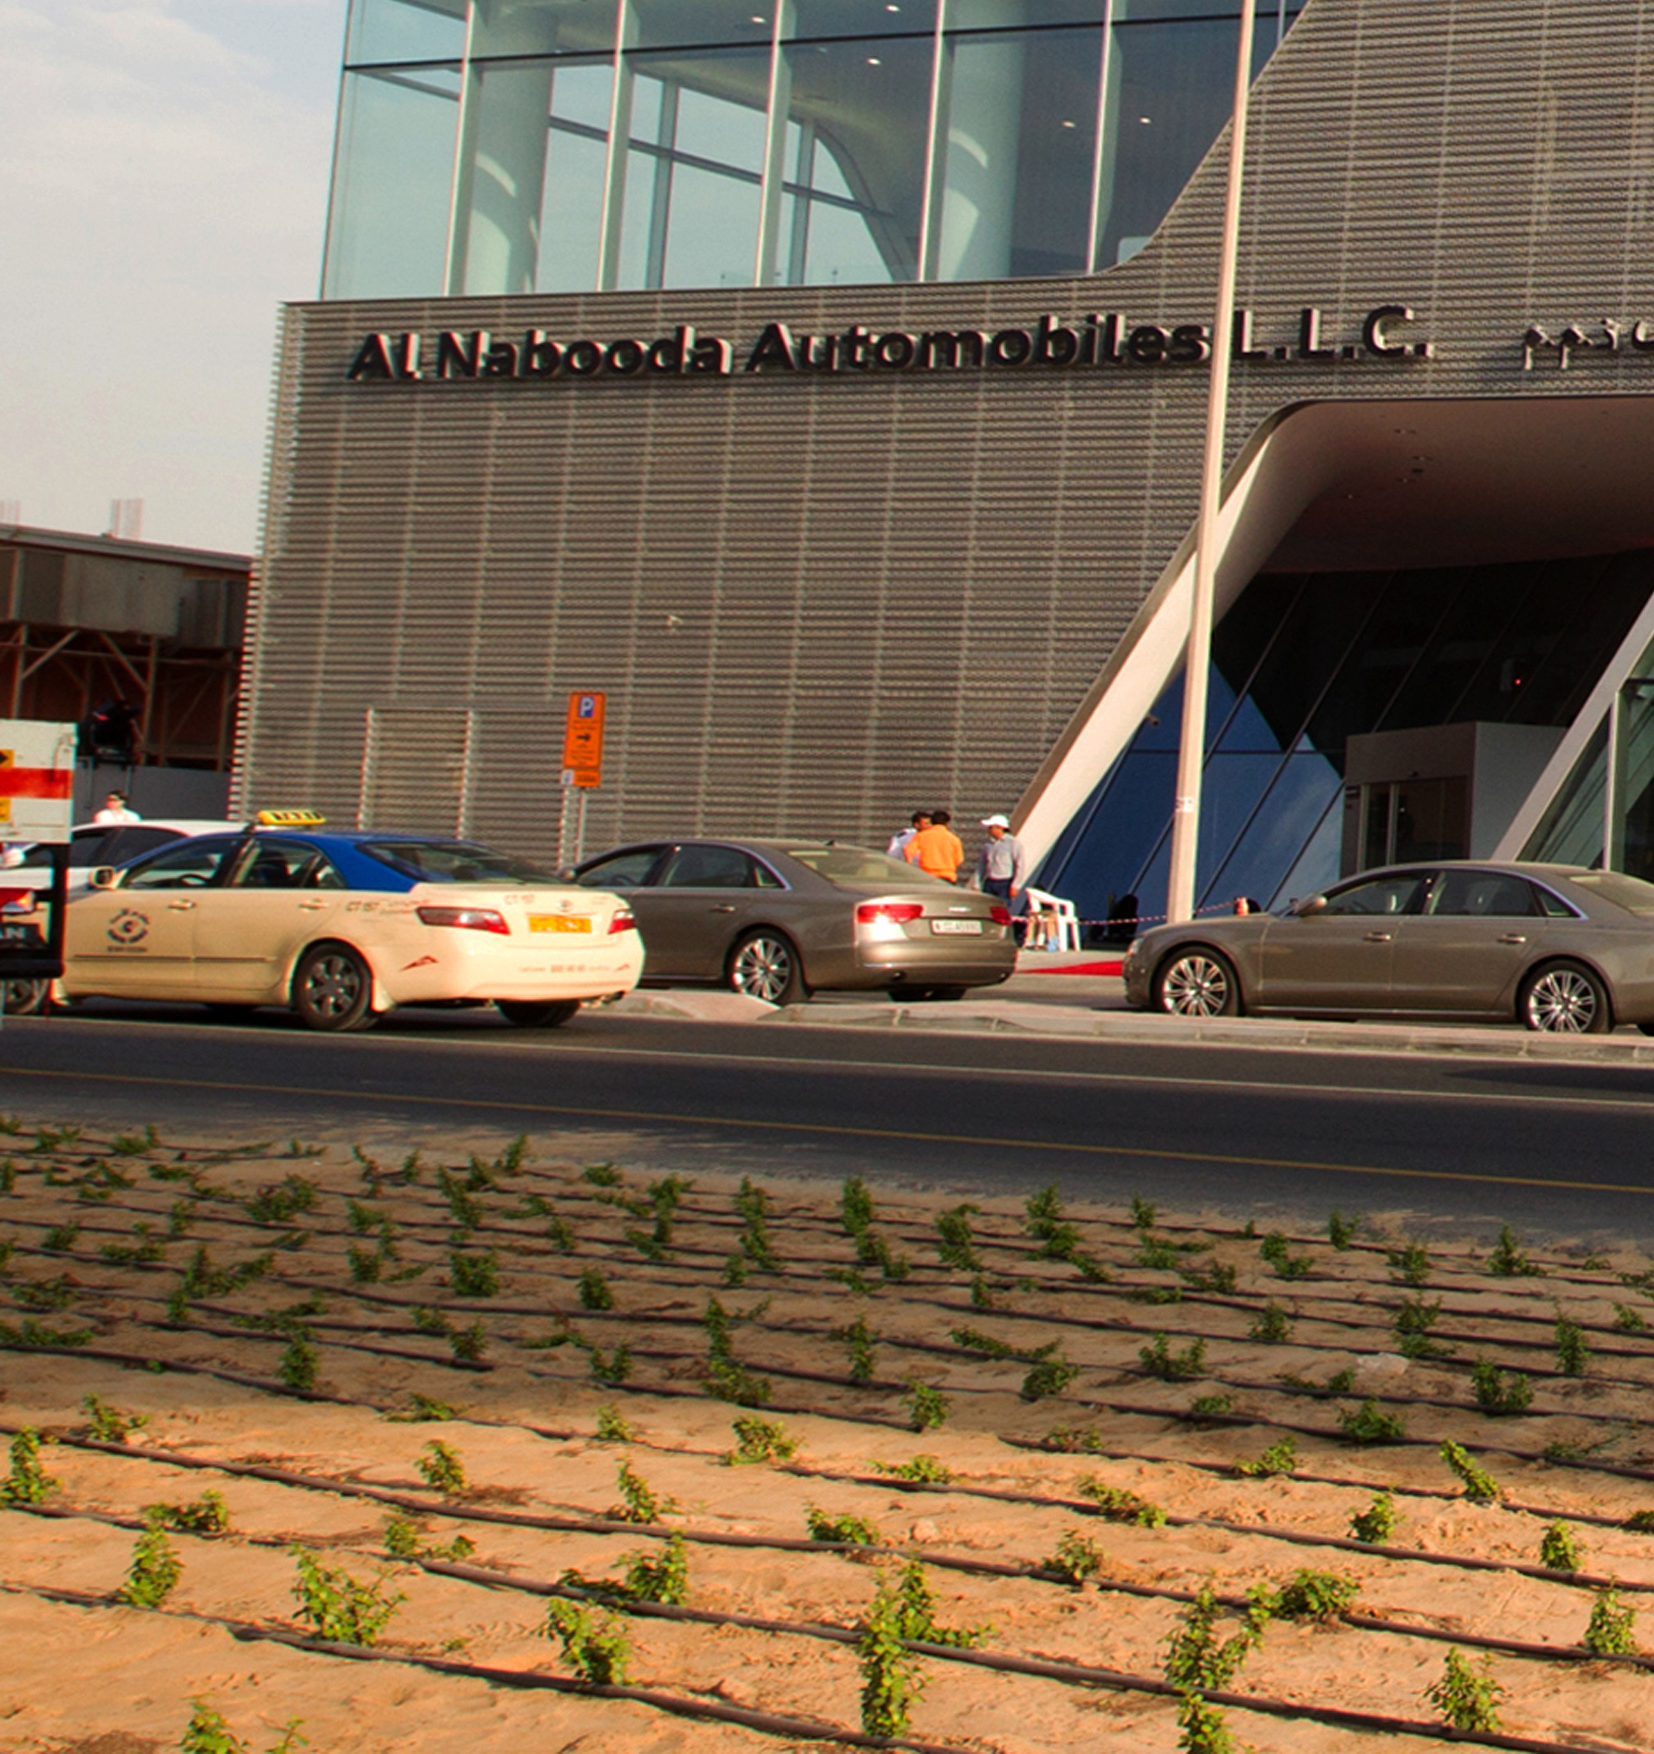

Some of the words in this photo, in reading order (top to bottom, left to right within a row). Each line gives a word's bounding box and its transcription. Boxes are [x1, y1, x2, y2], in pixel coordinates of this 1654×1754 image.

[347, 333, 422, 380] Al
[436, 325, 732, 378] Nabooda
[745, 313, 1212, 372] Automobiles
[1231, 305, 1434, 360] L.L.C.
[580, 696, 594, 717] P
